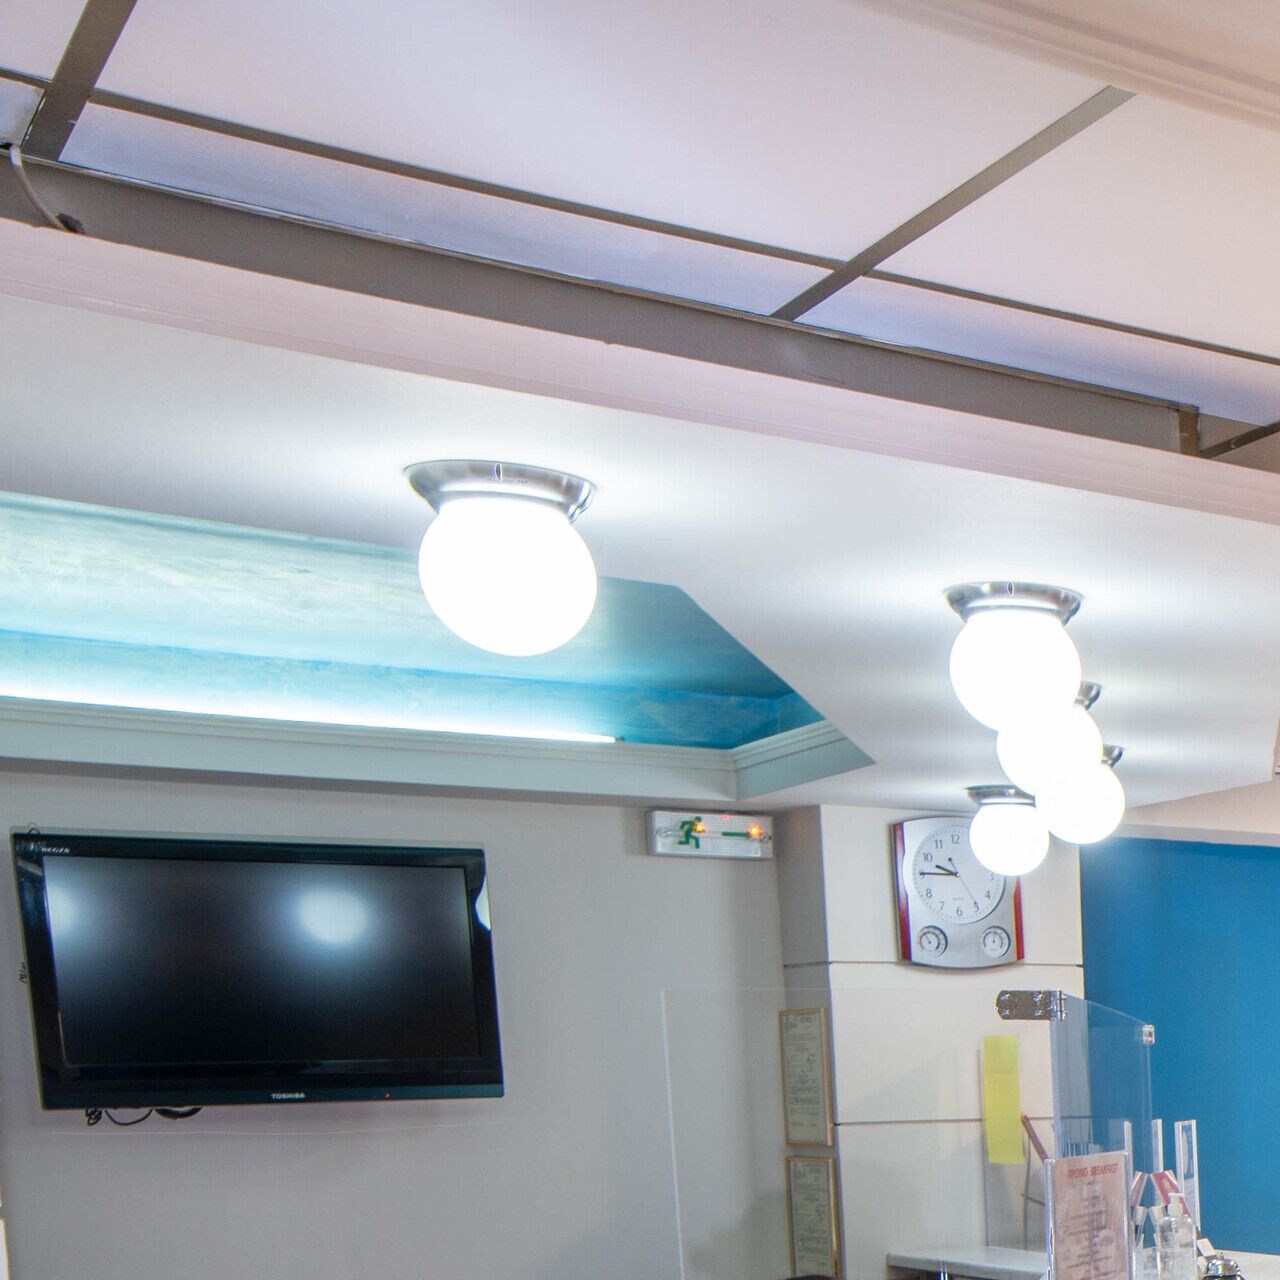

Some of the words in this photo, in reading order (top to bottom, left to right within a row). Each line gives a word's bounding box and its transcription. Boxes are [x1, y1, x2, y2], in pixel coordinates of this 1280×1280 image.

[934, 839, 943, 849] 11
[951, 834, 960, 845] 12
[922, 852, 933, 862] 10
[926, 888, 933, 898] 8
[985, 890, 991, 899] 4
[938, 901, 945, 912] 7
[973, 902, 979, 912] 5
[956, 907, 963, 917] 6
[271, 1092, 306, 1100] TOSHIBA
